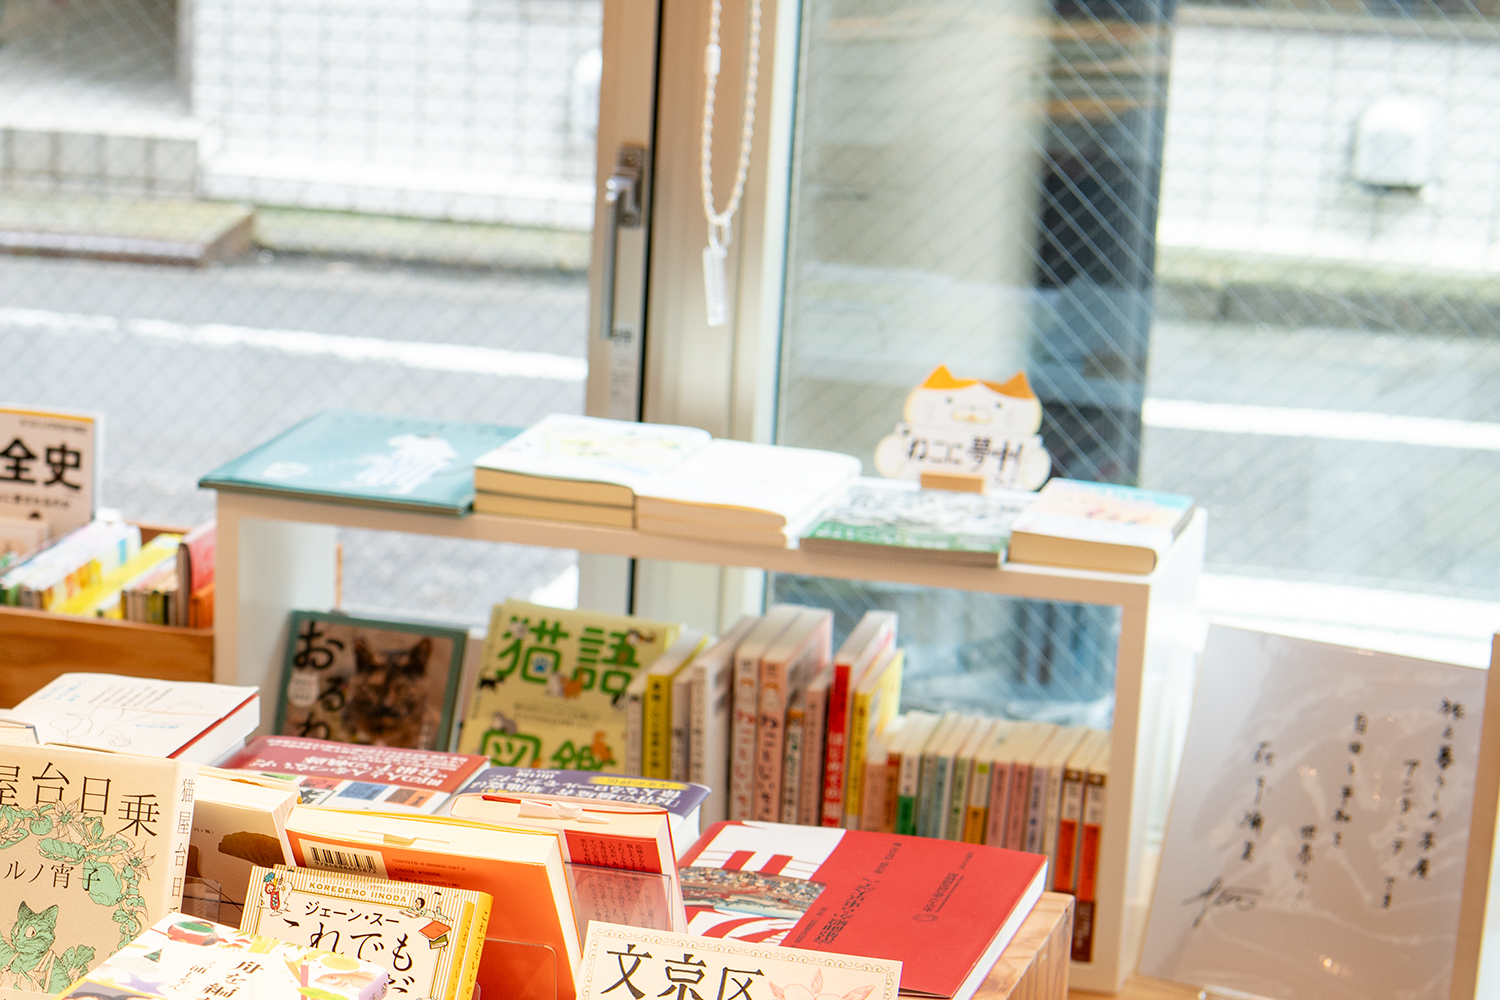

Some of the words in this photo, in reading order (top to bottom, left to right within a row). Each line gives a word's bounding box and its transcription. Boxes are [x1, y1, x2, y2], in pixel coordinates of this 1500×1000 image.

[497, 615, 641, 695] 猫語
[314, 861, 377, 874] 9784888665872
[309, 882, 367, 897] KOREDEMO
[370, 891, 407, 903] IINODA
[305, 900, 400, 927] ジェーン・スー
